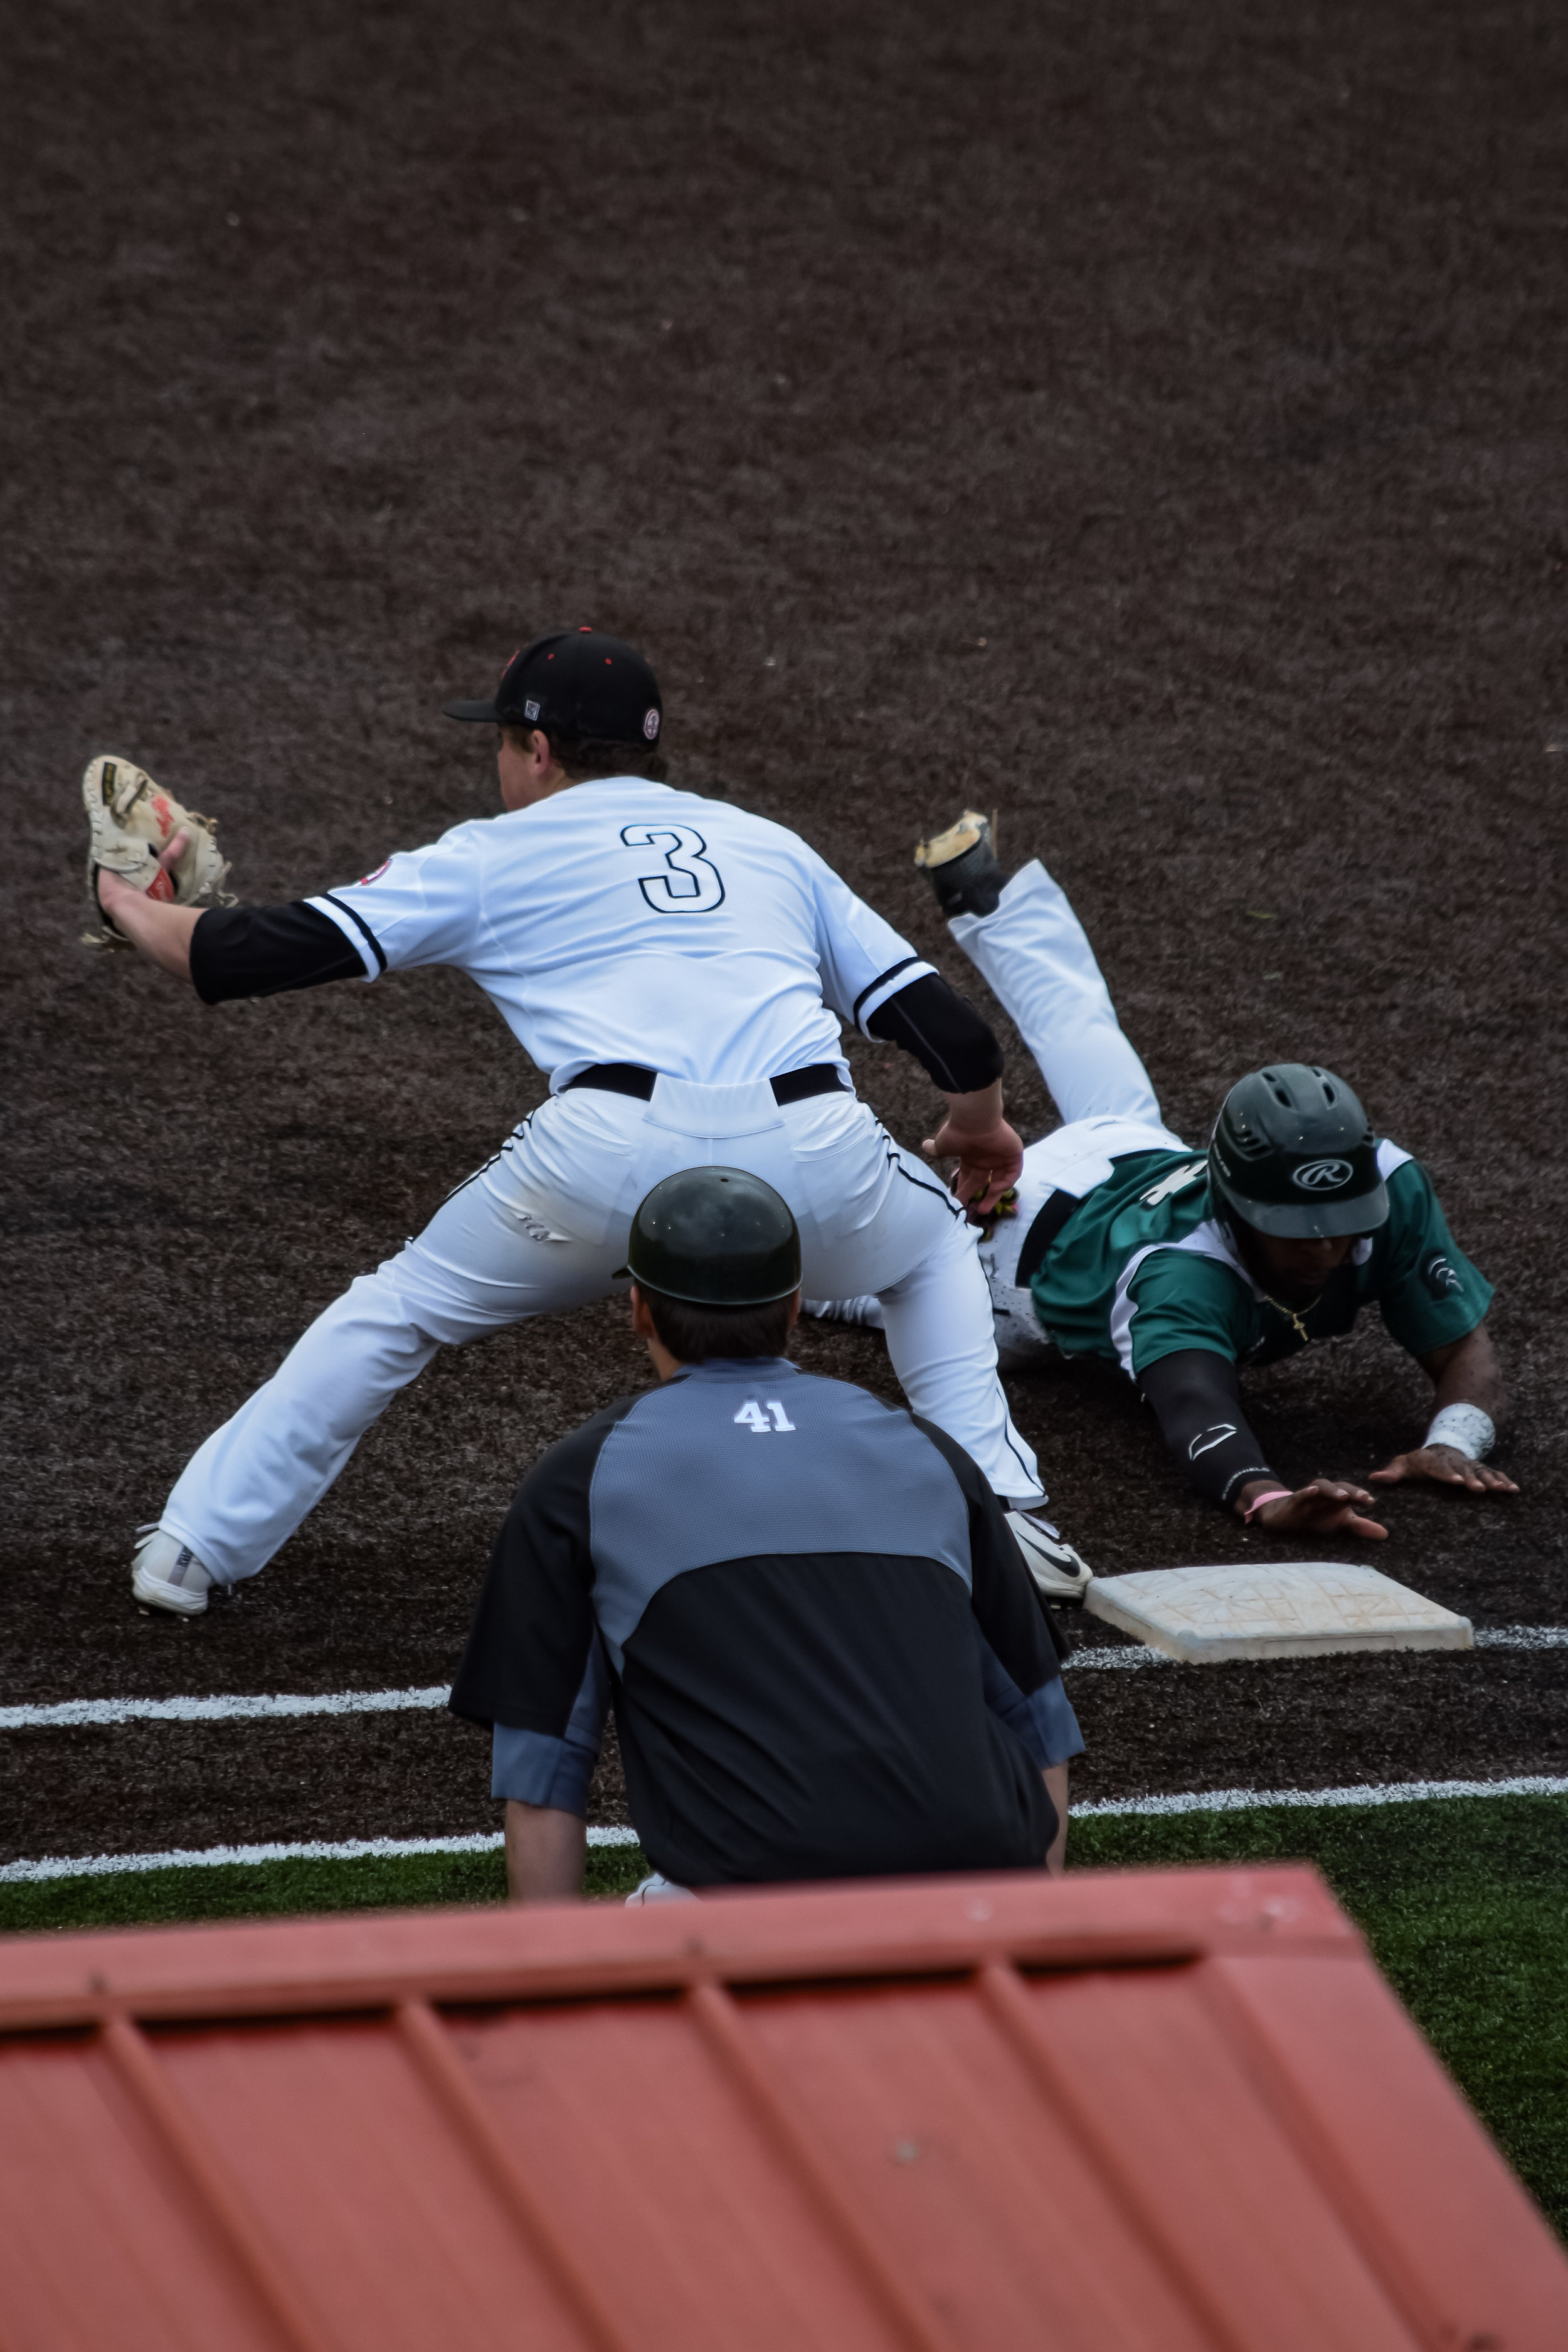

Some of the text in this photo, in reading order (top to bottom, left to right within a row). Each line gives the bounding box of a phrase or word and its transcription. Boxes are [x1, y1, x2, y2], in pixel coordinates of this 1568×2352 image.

[620, 824, 726, 913] 3
[1301, 1163, 1342, 1185] R
[734, 1400, 796, 1433] 41
